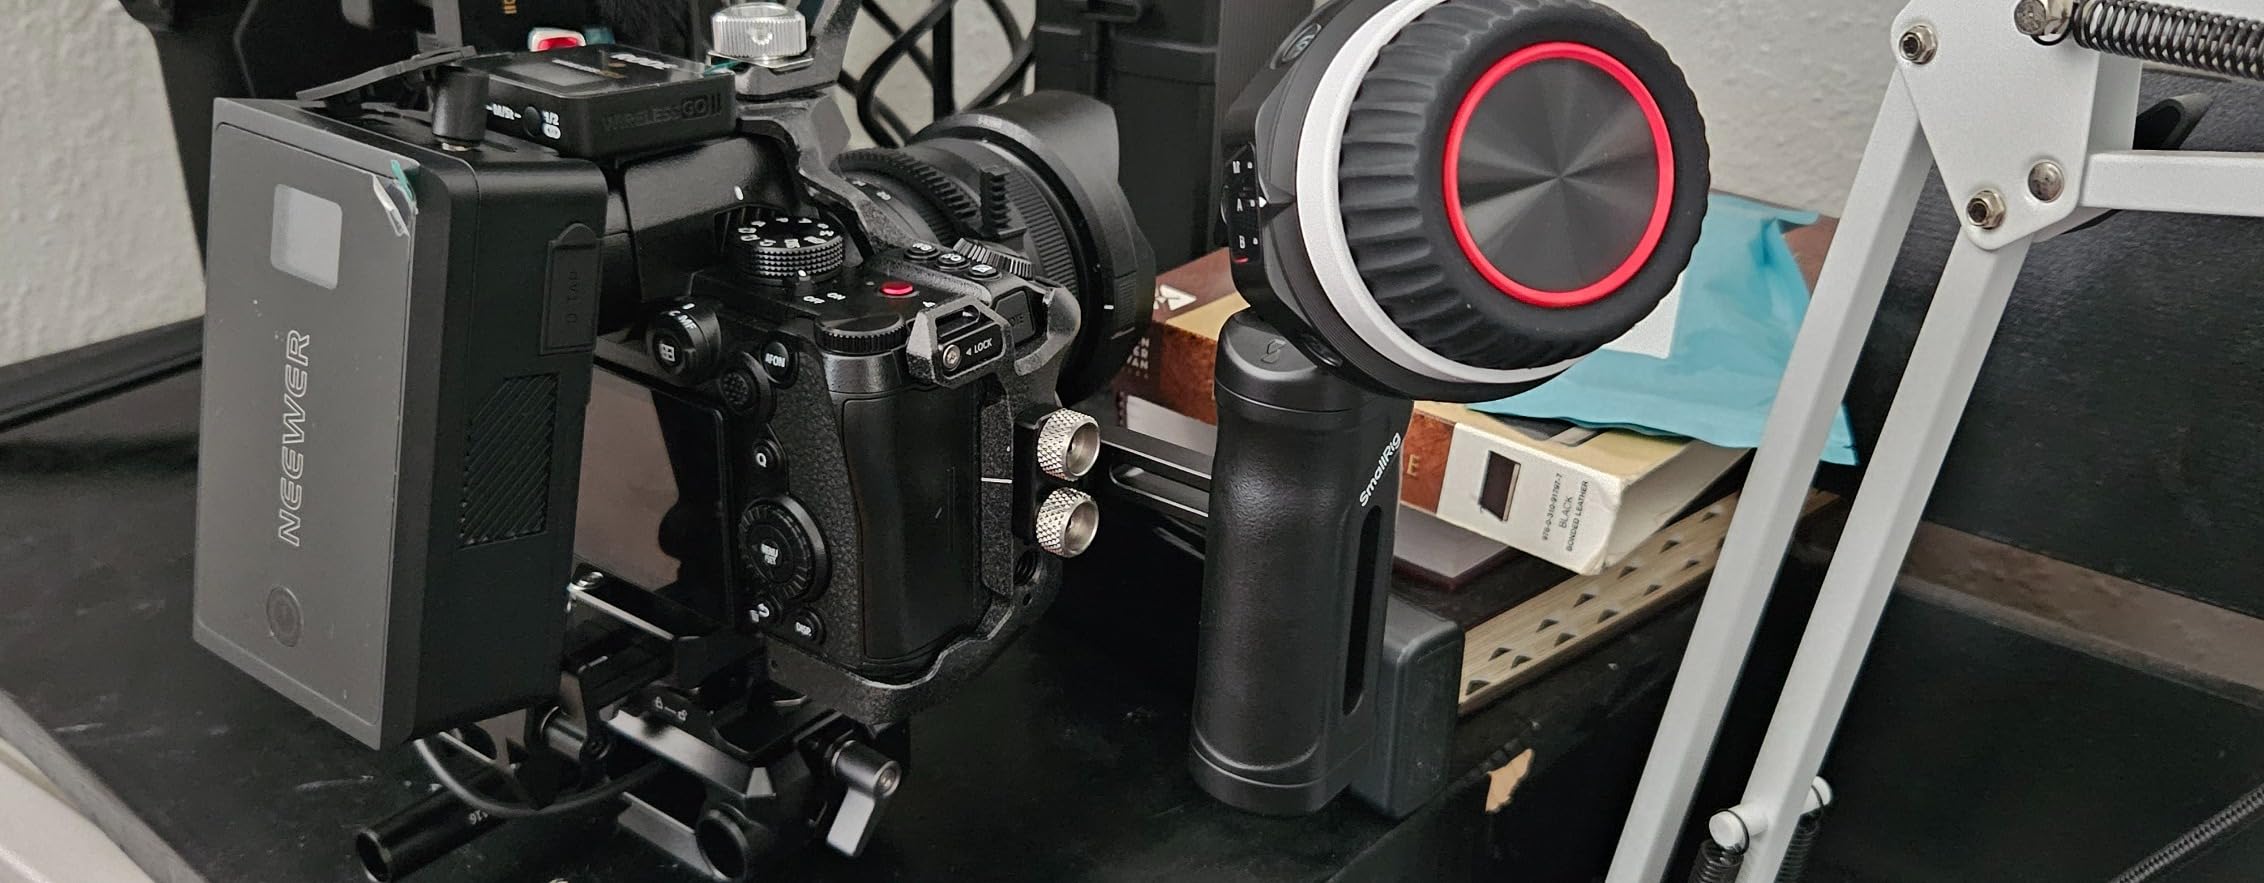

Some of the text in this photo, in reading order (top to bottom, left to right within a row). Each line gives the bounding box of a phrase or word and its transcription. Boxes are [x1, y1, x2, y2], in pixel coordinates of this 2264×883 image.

[973, 337, 993, 355] LOCK
[277, 328, 310, 547] NEEWER
[755, 452, 767, 468] Q
[1359, 432, 1402, 507] SmallRig
[1558, 495, 1574, 529] BLACK
[1566, 480, 1589, 552] BONDED LEATHER
